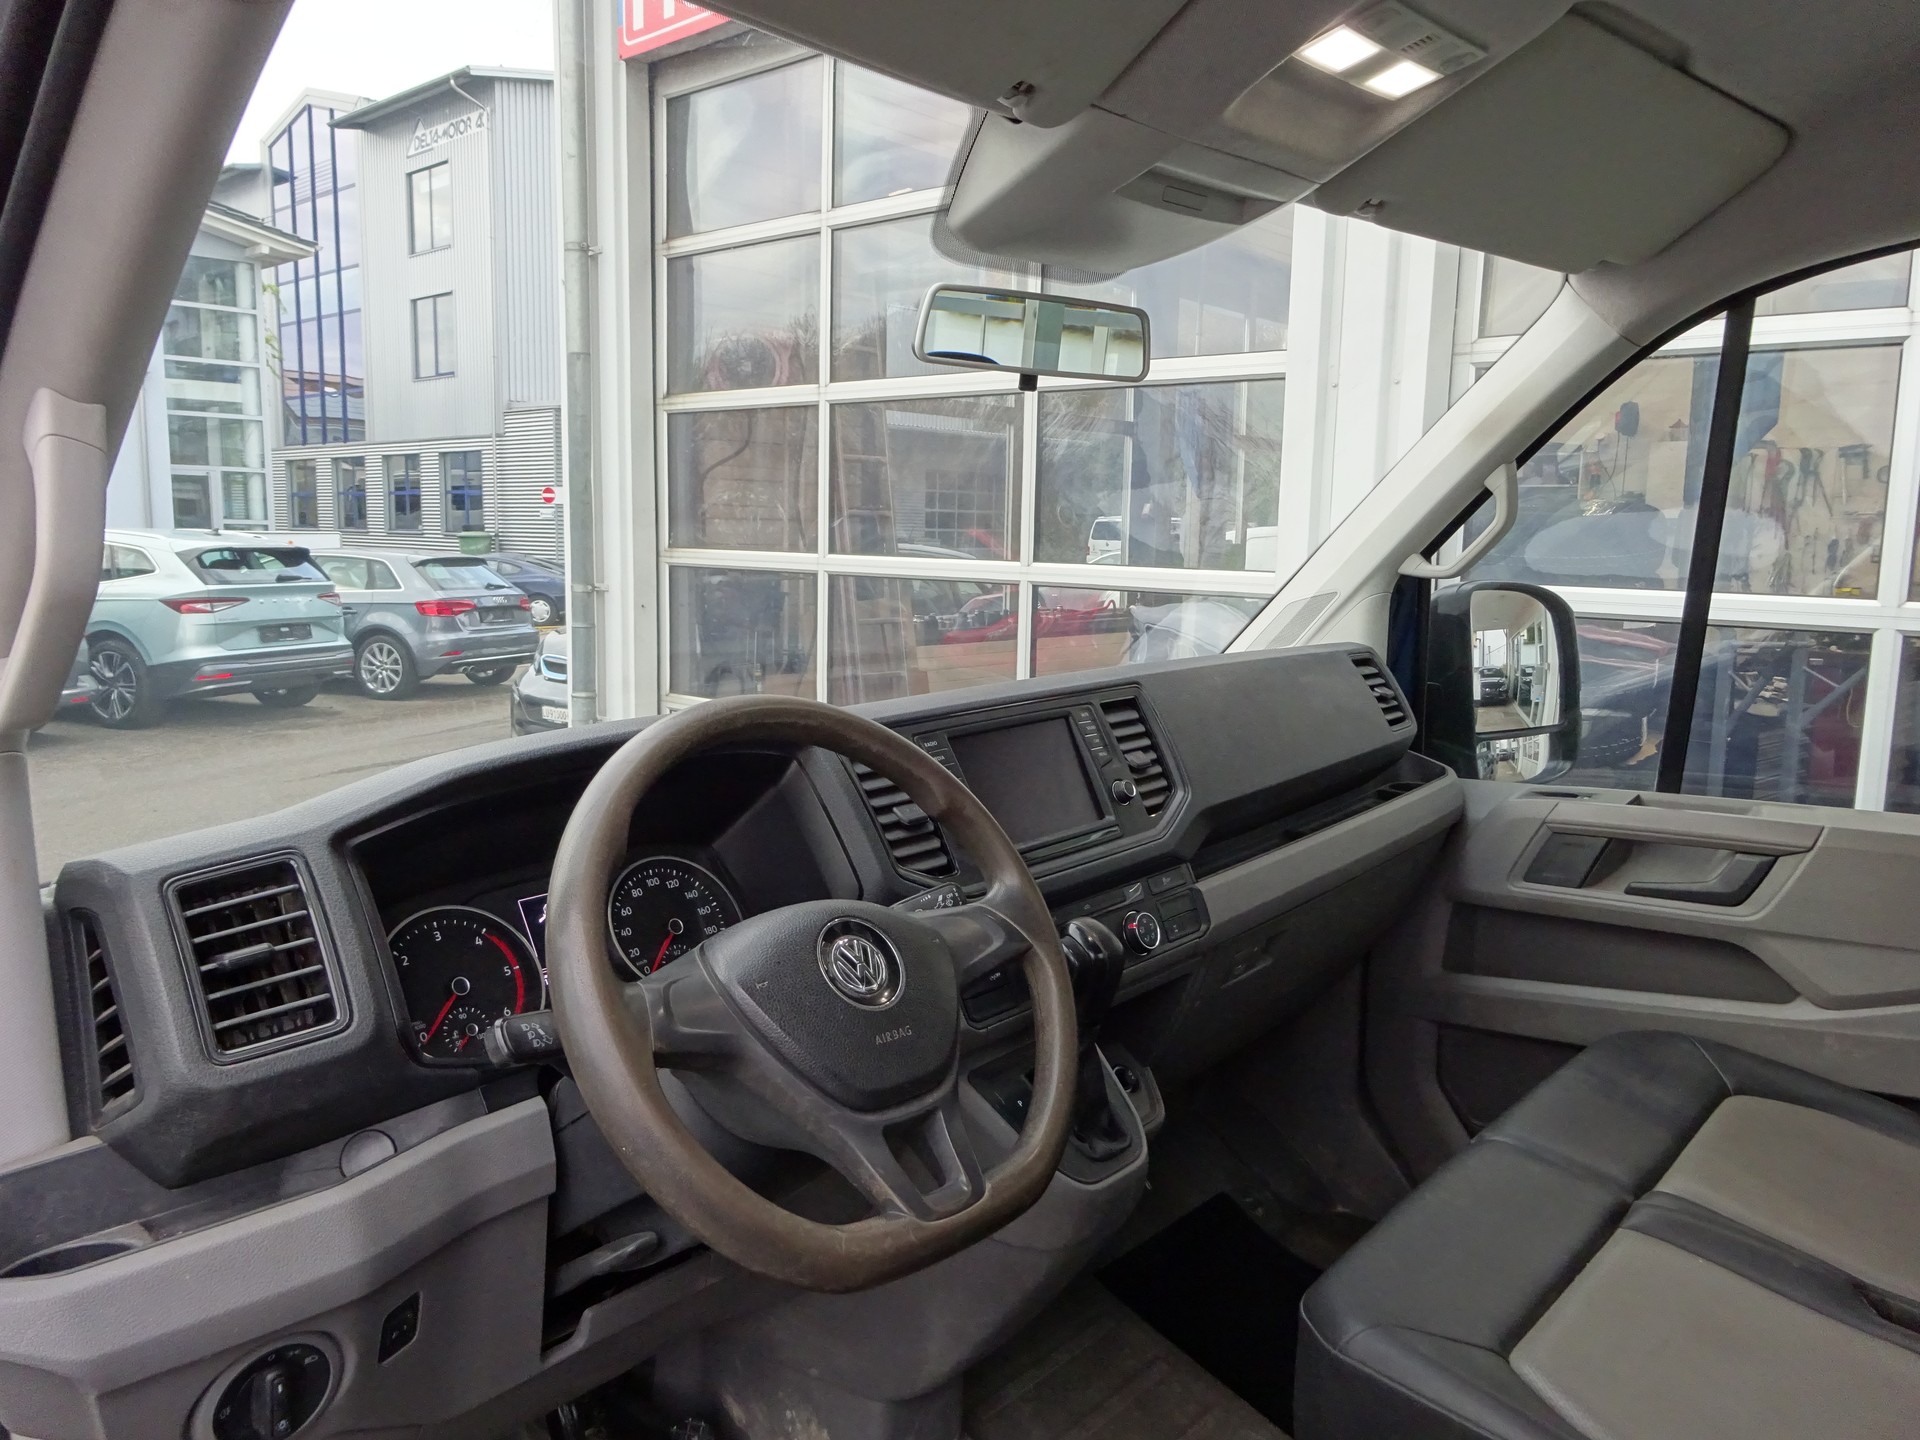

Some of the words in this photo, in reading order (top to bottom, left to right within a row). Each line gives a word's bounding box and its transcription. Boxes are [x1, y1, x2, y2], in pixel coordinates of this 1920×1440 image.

[646, 877, 660, 887] 100
[666, 879, 680, 889] 120
[631, 888, 643, 898] 80
[684, 890, 699, 900] 140
[621, 906, 632, 917] 60
[697, 905, 711, 916] 160
[620, 927, 632, 937] 40
[704, 925, 718, 935] 180
[433, 931, 442, 942] 3
[475, 936, 483, 946] 4
[628, 947, 640, 958] 20
[401, 955, 410, 966] 2
[503, 965, 512, 976] 5
[643, 965, 651, 974] 0
[504, 1006, 511, 1017] 6
[420, 1031, 428, 1042] 0
[875, 1025, 912, 1045] AIRBAG
